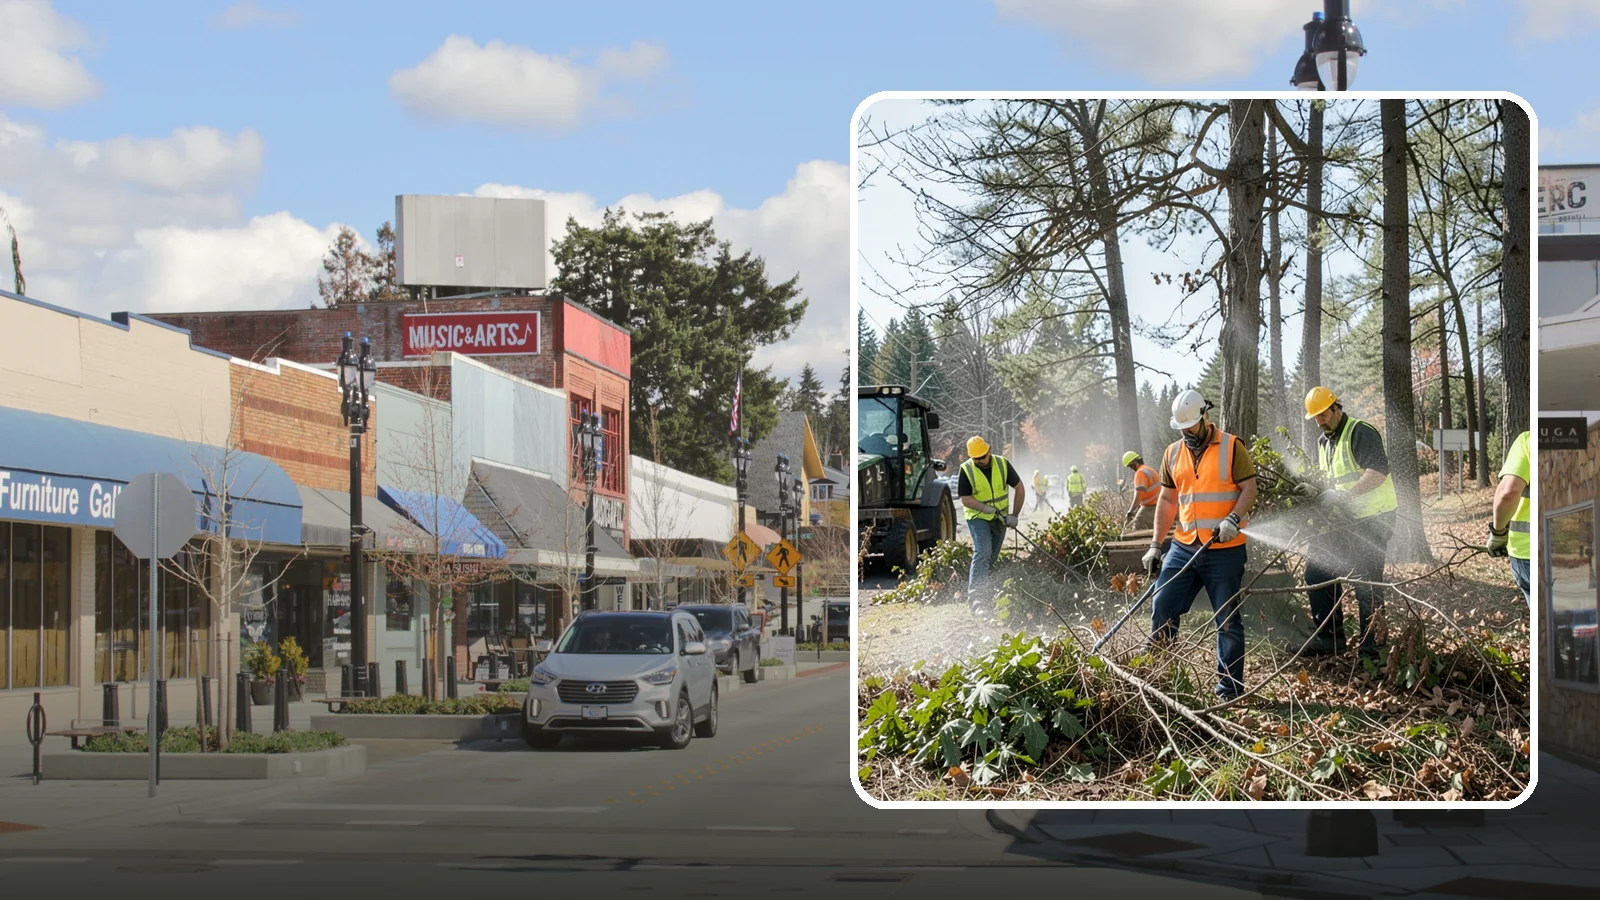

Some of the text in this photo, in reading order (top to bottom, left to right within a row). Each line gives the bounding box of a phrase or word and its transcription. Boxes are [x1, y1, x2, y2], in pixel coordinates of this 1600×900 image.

[1540, 427, 1577, 436] UGA
[0, 471, 121, 519] Furniture Gal
